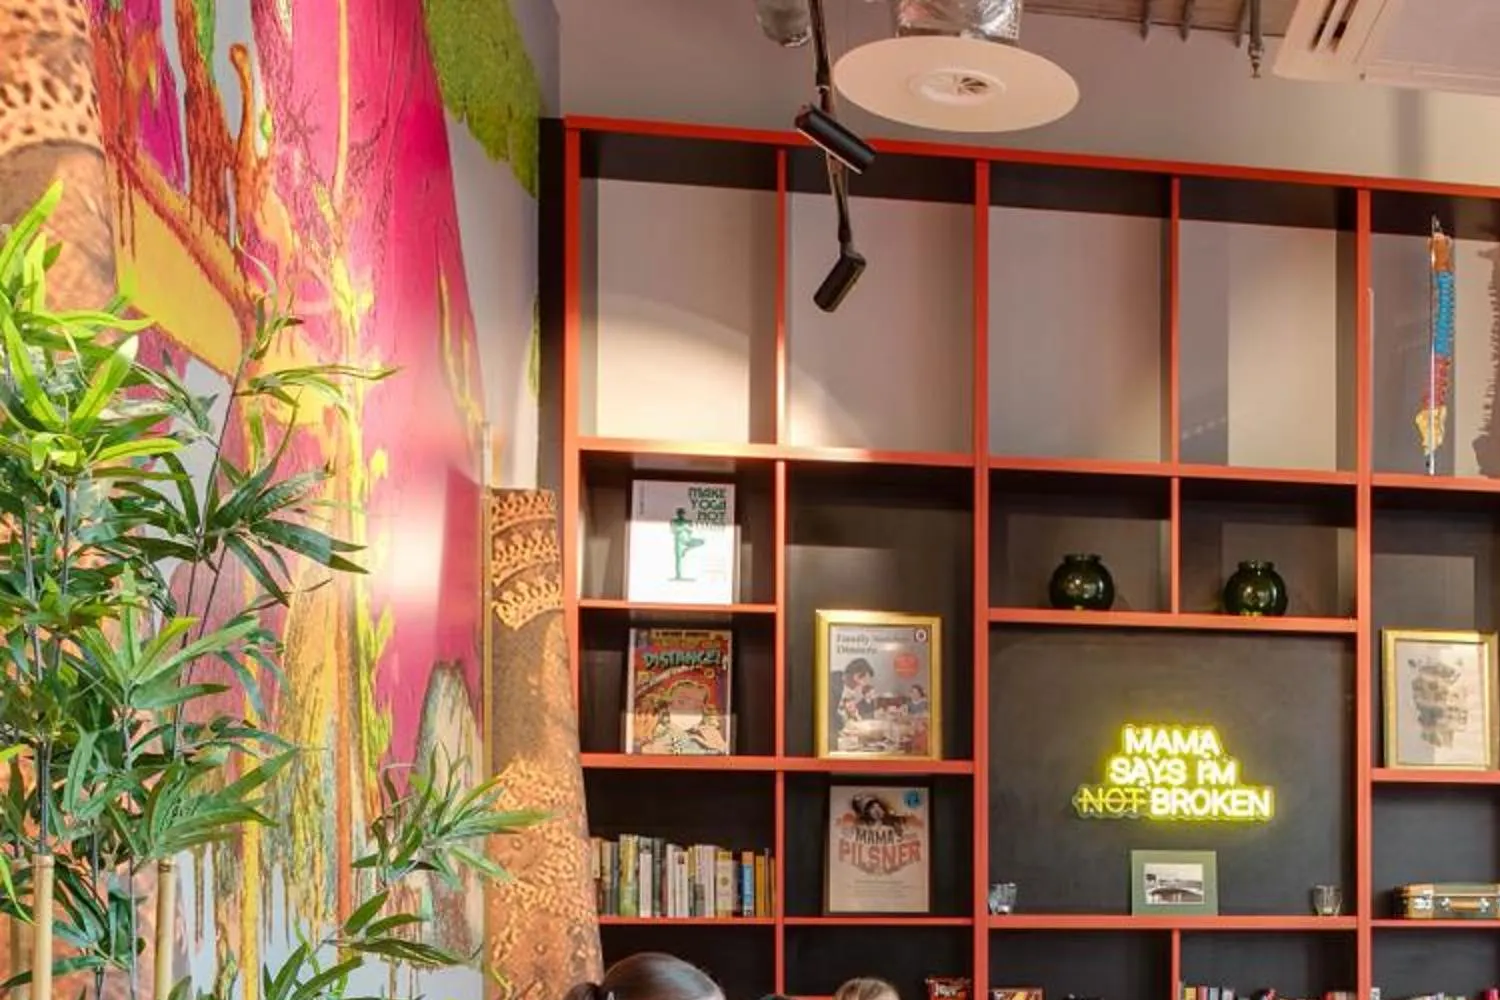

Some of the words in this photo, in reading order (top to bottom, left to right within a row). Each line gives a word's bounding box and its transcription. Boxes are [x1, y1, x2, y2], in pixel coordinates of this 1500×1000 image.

[1124, 726, 1220, 755] MAMA
[1109, 757, 1186, 785] SAYS
[1197, 758, 1236, 785] I'M
[1080, 787, 1145, 814] NOT
[1150, 787, 1271, 817] BROKEN
[838, 838, 921, 872] PILSNER
